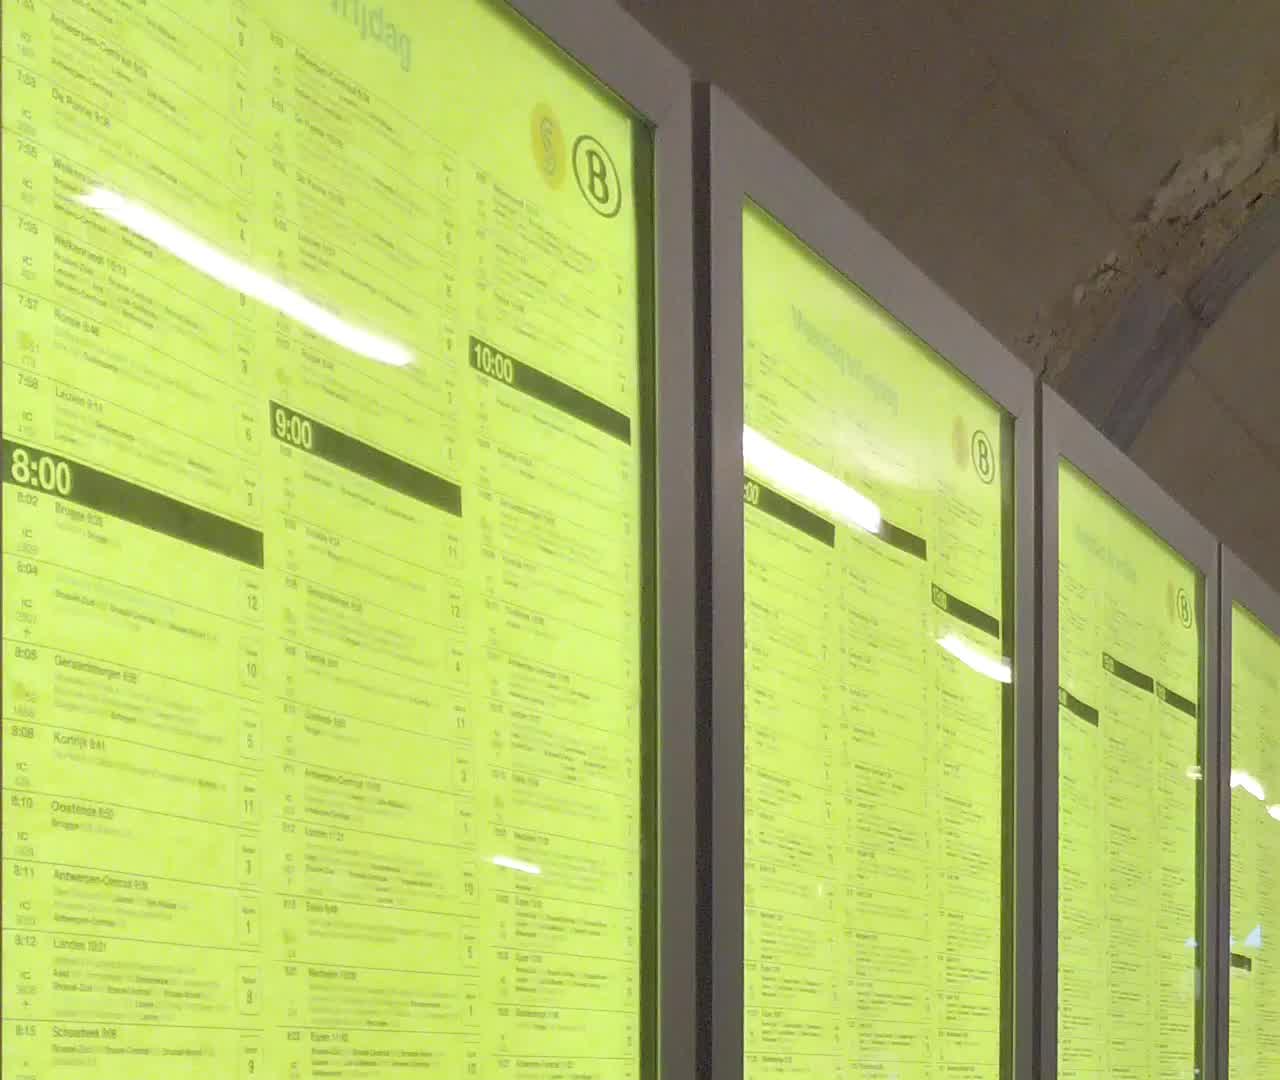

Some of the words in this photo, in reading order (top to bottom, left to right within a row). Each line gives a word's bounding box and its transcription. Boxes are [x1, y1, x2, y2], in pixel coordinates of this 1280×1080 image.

[472, 344, 513, 384] 10:00
[275, 410, 313, 448] 9:00
[11, 448, 71, 495] 8:00
[17, 492, 39, 506] 8:02
[17, 561, 38, 576] 8:04
[11, 725, 34, 739] 8:08
[15, 936, 36, 947] 8:12
